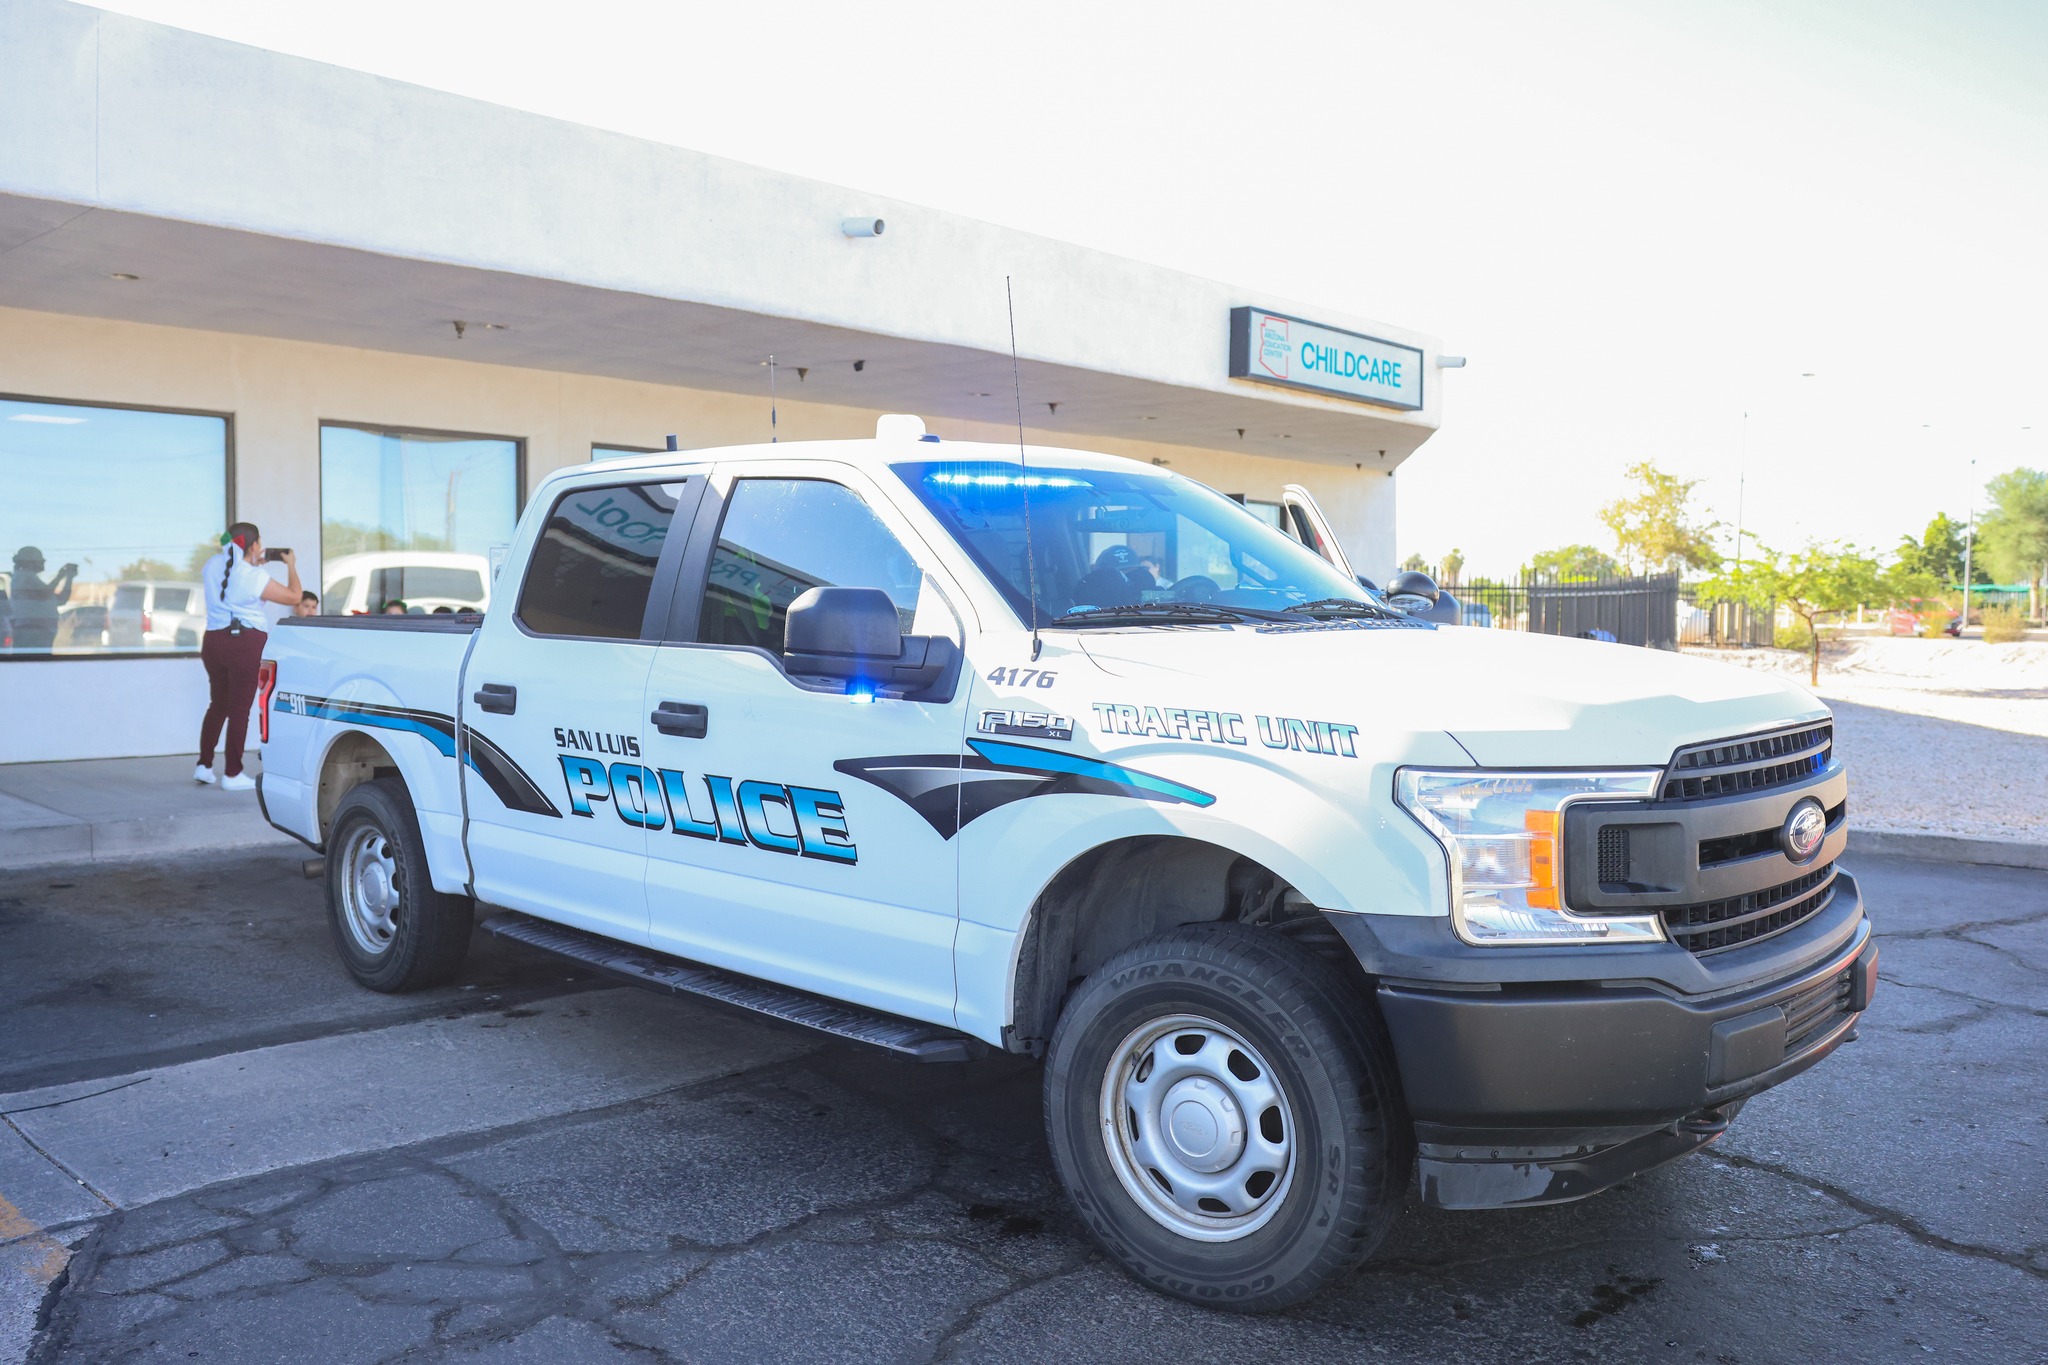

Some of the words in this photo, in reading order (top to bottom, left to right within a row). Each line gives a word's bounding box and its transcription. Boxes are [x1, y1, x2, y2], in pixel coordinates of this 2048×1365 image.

[1301, 341, 1401, 388] CHILDCARE
[986, 666, 1058, 689] 4176
[290, 693, 306, 715] 911
[554, 727, 593, 751] SAN
[595, 732, 641, 758] LUIS
[1092, 702, 1247, 746] TRAFFIC
[1255, 715, 1359, 759] UNIT
[557, 754, 858, 866] POLICE
[1109, 962, 1312, 1059] WRANGLER
